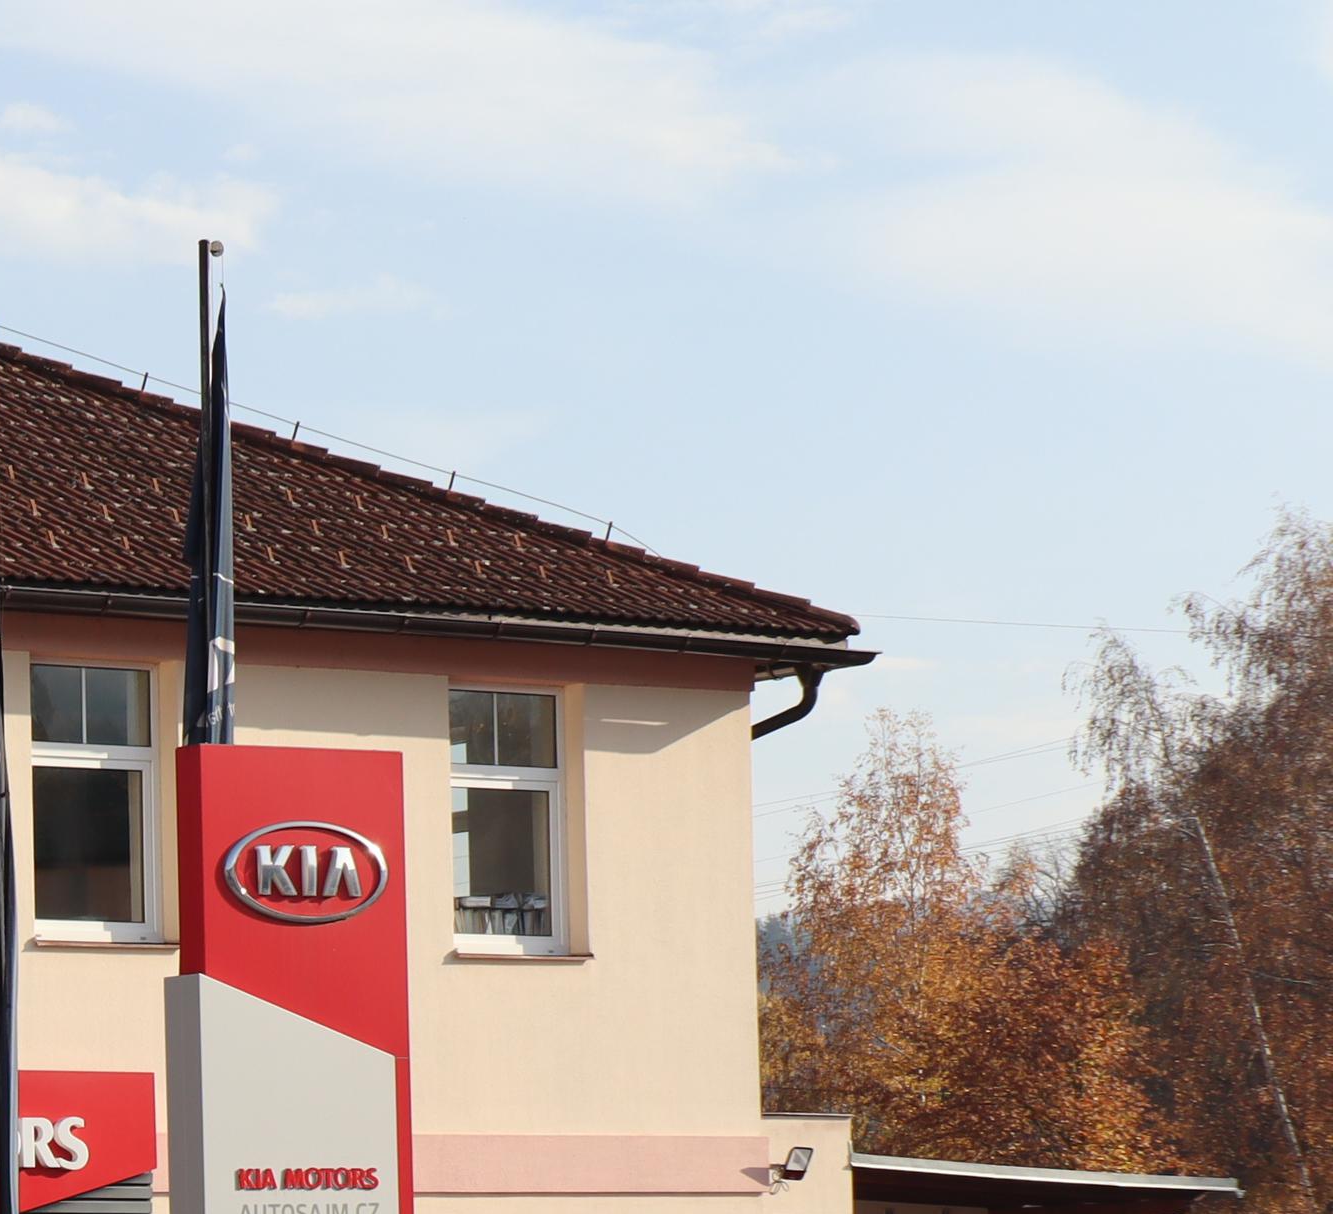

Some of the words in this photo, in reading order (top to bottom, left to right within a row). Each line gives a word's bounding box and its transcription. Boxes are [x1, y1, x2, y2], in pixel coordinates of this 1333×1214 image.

[255, 844, 363, 898] KIA
[236, 1168, 278, 1192] KIA
[284, 1167, 380, 1191] MOTORS
